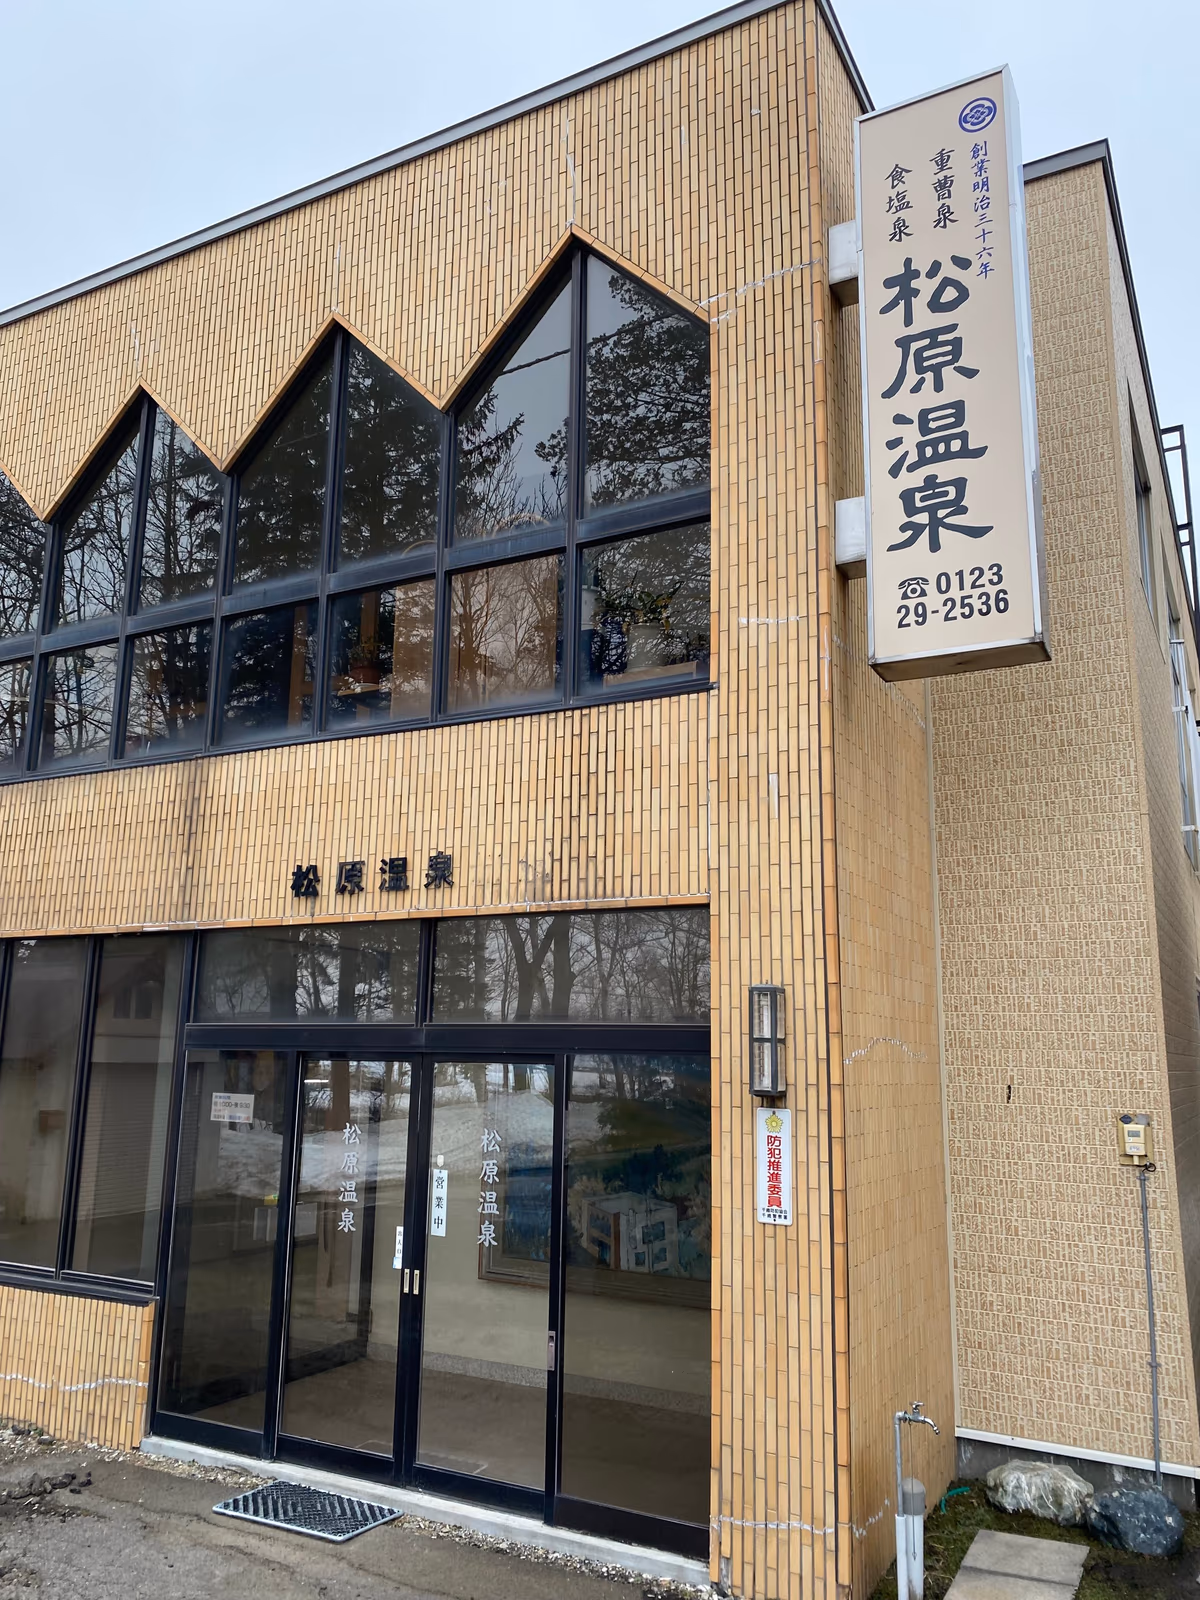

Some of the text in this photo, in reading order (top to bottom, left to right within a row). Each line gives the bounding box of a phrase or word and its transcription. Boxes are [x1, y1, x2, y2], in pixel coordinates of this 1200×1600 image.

[884, 164, 914, 243] 食塩泉
[929, 148, 959, 229] 重曹泉
[970, 140, 995, 280] 創業明治三十六年
[879, 254, 994, 553] 松原温泉
[896, 588, 1010, 629] 29-2536
[936, 563, 1004, 595] 0123
[290, 851, 455, 898] 松原温泉
[337, 1122, 361, 1233] 松原温泉
[433, 1176, 445, 1229] 営業中
[477, 1128, 502, 1247] 松原温泉
[766, 1135, 782, 1208] 防犯推進委員
